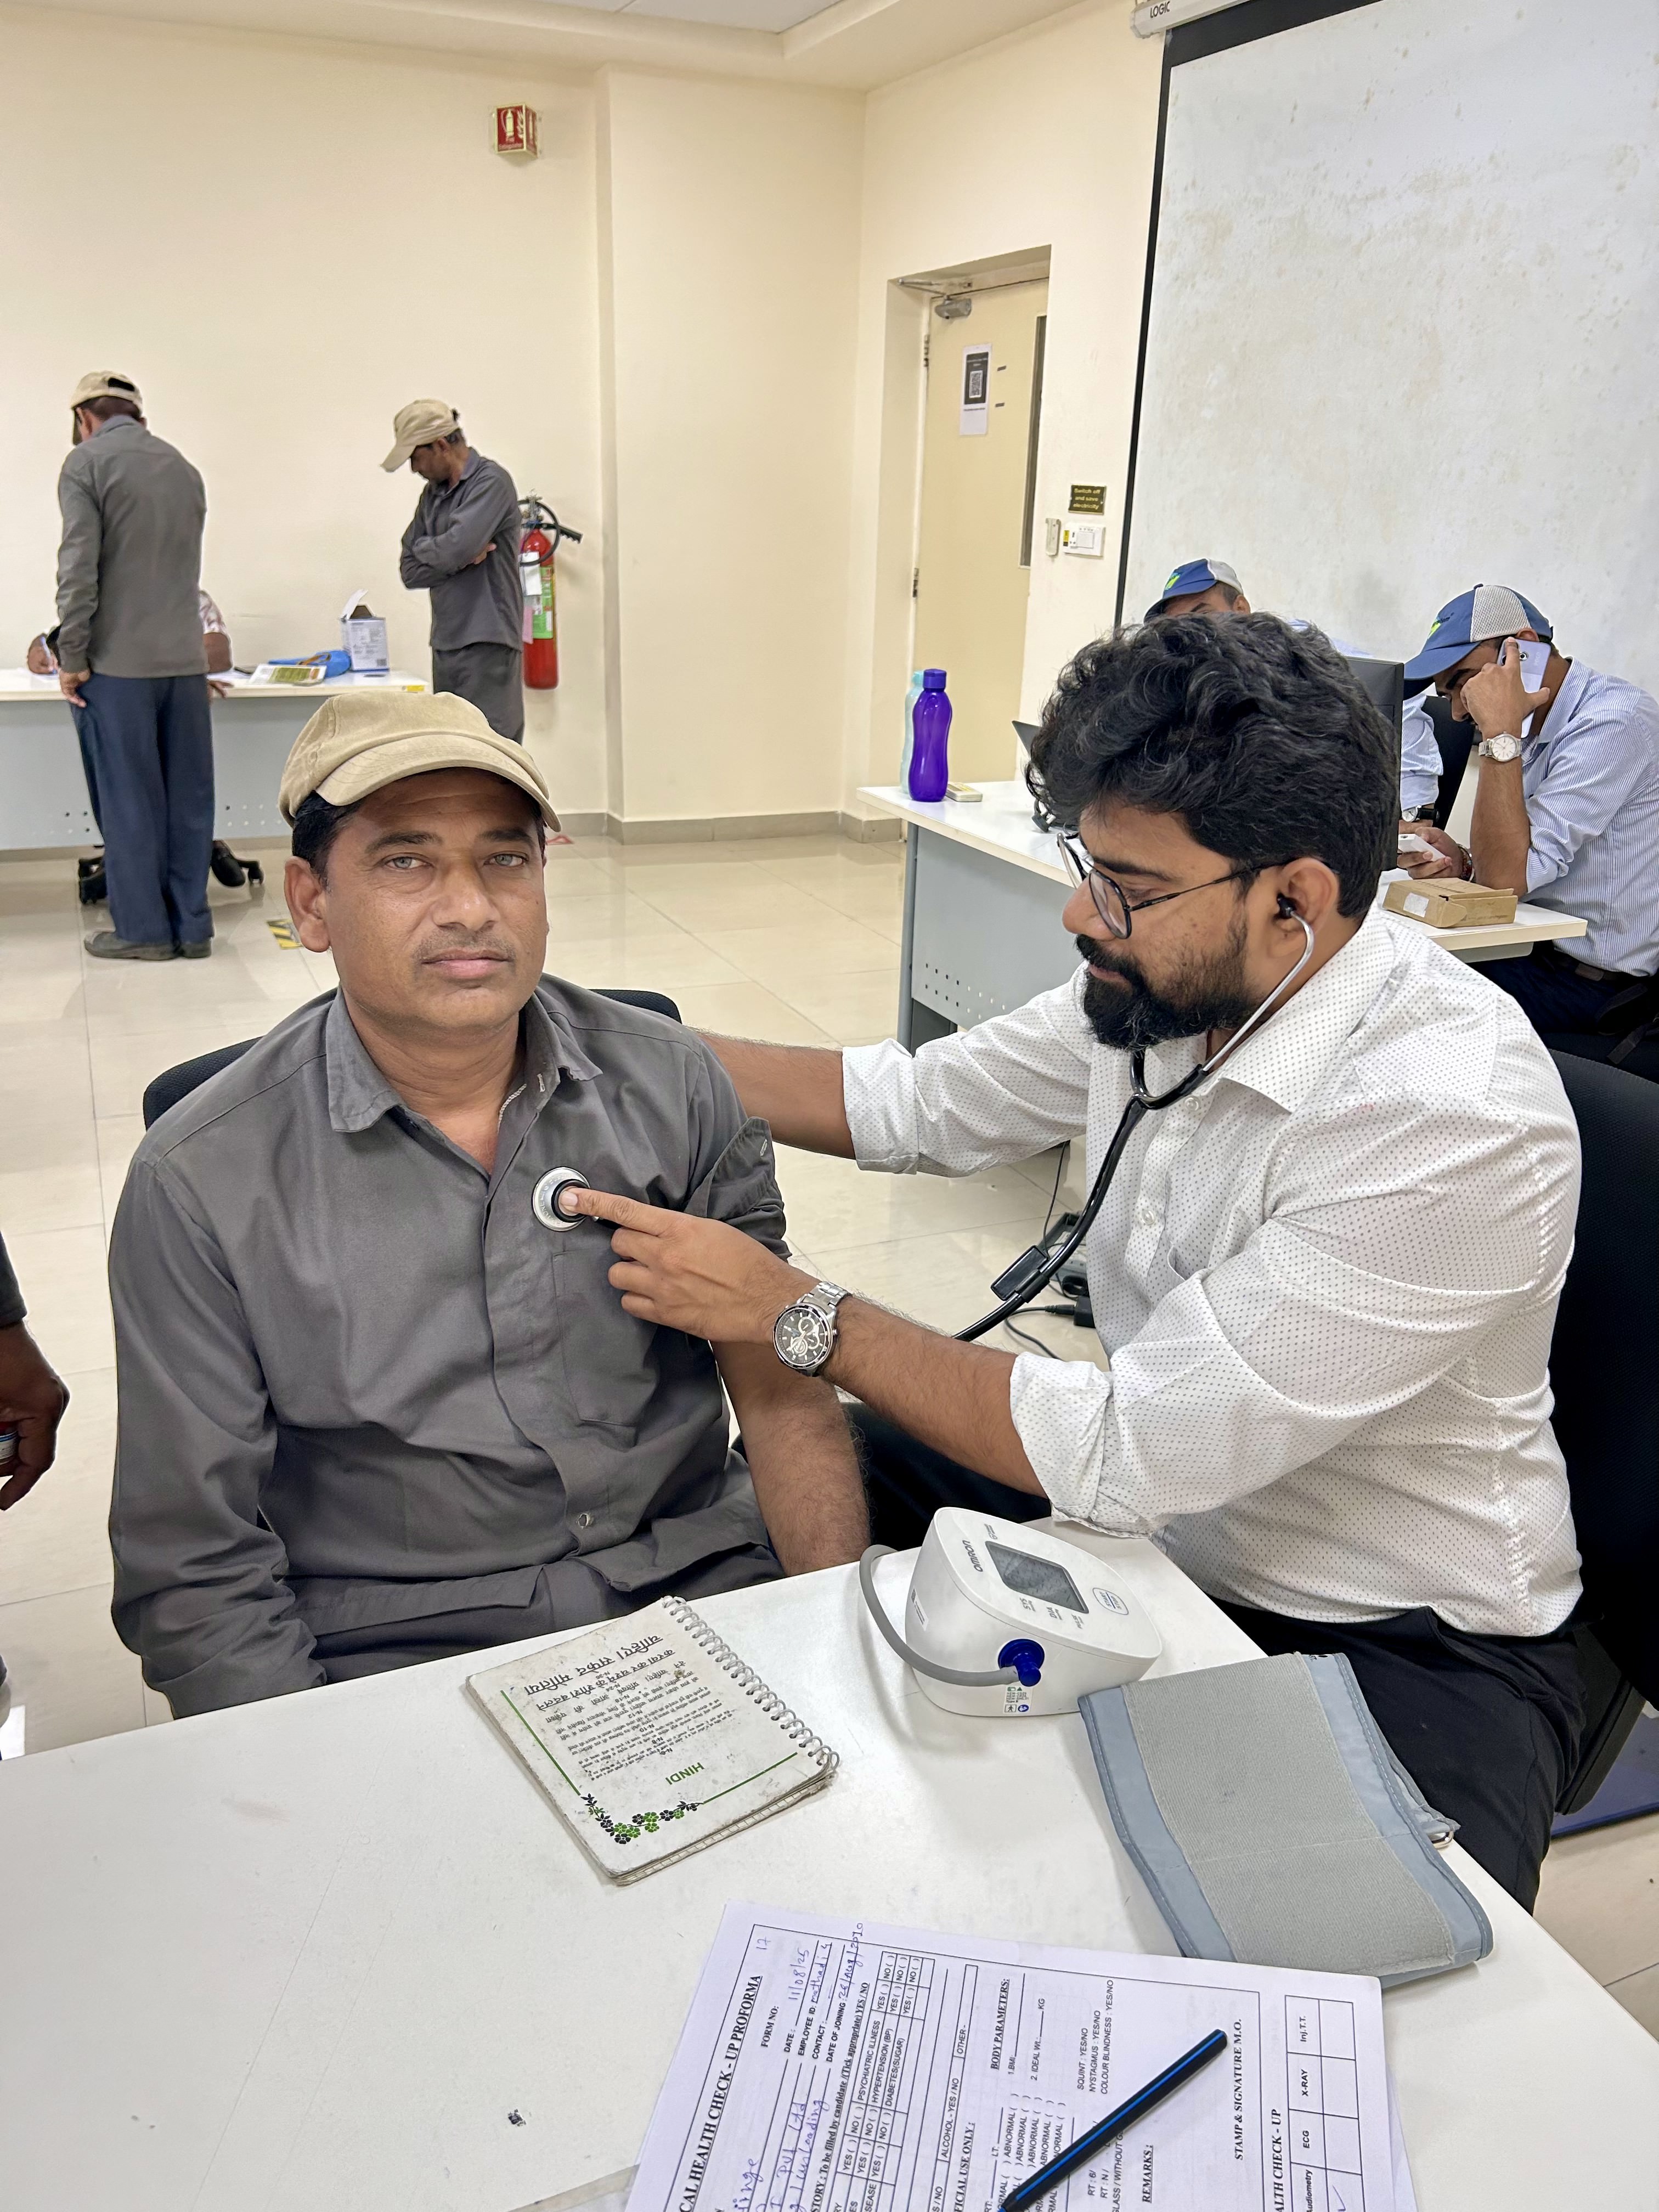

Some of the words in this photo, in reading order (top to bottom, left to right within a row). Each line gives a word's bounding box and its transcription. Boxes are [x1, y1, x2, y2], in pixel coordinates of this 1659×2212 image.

[1150, 1, 1170, 18] LOGIC
[962, 1540, 983, 1572] OMRON
[1046, 1607, 1057, 1619] DIA
[616, 1635, 663, 1660] चाहिए।
[647, 1649, 675, 1664] करवा
[574, 1656, 616, 1677] सफेद
[605, 1669, 632, 1683] चश्मे
[630, 1662, 649, 1672] कर
[644, 1669, 670, 1681] चाहिए।
[523, 1674, 573, 1695] मोतिया
[569, 1684, 596, 1699] शीशे
[595, 1679, 608, 1689] के
[605, 1683, 620, 1692] N-24
[616, 1681, 640, 1696] प्रतिवर्ष
[535, 1695, 571, 1712] बदलने
[614, 1694, 630, 1703] N-18
[627, 1709, 643, 1718] N-12
[639, 1723, 654, 1733] N-10
[664, 1762, 704, 1785] HINDI
[883, 1967, 891, 1979] NO
[895, 1969, 904, 1980] NO
[909, 1971, 917, 1982] NO
[859, 1982, 870, 1994] NO
[1105, 1979, 1114, 2011] YES/NO
[730, 1976, 761, 2041] PROFORMA
[855, 1999, 866, 2015] YES
[877, 1995, 885, 2009] YES
[889, 1997, 898, 2012] YES
[902, 2000, 911, 2014] YES
[994, 1978, 1010, 2043] PARAMETERS:
[1037, 1998, 1045, 2010] KG
[834, 2002, 846, 2030] JOINING
[1092, 2010, 1101, 2040] YES/NO
[760, 2021, 774, 2047] FORM
[768, 2006, 779, 2020] NO:
[797, 2016, 814, 2056] EMPLOYEE
[831, 2030, 838, 2041] OF
[1233, 2018, 1242, 2044] M.O.
[783, 2033, 794, 2052] DATE
[811, 2024, 826, 2059] CONTACT
[956, 2028, 966, 2054] OTHER
[1080, 2027, 1088, 2056] YES/NO
[1102, 2017, 1111, 2061] BLINDNESS
[724, 2042, 739, 2059] UP
[826, 2042, 836, 2062] DATE
[990, 2044, 1002, 2070] BODY
[857, 2050, 874, 2101] PSYCHIATRIC
[868, 2020, 881, 2049] ILLNESS
[871, 2043, 889, 2103] HYPERTENSION
[883, 2028, 893, 2042] (BP)
[1031, 2051, 1040, 2072] IDEAL
[1088, 2045, 1098, 2092] NYSTAGMUS
[884, 2038, 905, 2107] DIABETES(SUGAR)
[1076, 2061, 1085, 2090] SQUINT
[1100, 2062, 1109, 2094] COLOUR
[1233, 2047, 1242, 2112] SIGNATURE
[951, 2078, 959, 2090] NO
[708, 2070, 732, 2119] CHECK
[834, 2080, 848, 2118] candidate
[947, 2096, 957, 2112] YES
[829, 2119, 840, 2131] by
[1234, 2114, 1243, 2123] &
[1271, 2108, 1281, 2125] UP
[851, 2120, 859, 2134] NO
[865, 2123, 873, 2136] NO
[878, 2126, 887, 2139] NO
[1003, 2112, 1015, 2158] ABNORMAL
[825, 2129, 838, 2151] filled
[941, 2119, 953, 2158] ALCOHOL
[962, 2126, 975, 2155] ONLY
[1015, 2116, 1027, 2162] ABNORMAL
[1028, 2118, 1039, 2163] ABNORMAL
[1040, 2121, 1051, 2166] ABNORMAL
[1234, 2124, 1243, 2160] STAMP
[1302, 2130, 1310, 2148] ECG
[688, 2121, 719, 2181] HEALTH
[821, 2152, 833, 2163] be
[1114, 2141, 1122, 2180] WITHOUT
[1272, 2135, 1283, 2179] CHECK
[819, 2164, 830, 2175] To
[842, 2154, 853, 2170] YES
[857, 2156, 867, 2173] YES
[871, 2160, 881, 2176] YES
[959, 2155, 970, 2176] USE
[1142, 2149, 1153, 2203] REMARKS
[934, 2186, 943, 2199] NO
[1087, 2183, 1095, 2196] RT
[1100, 2186, 1108, 2198] RT
